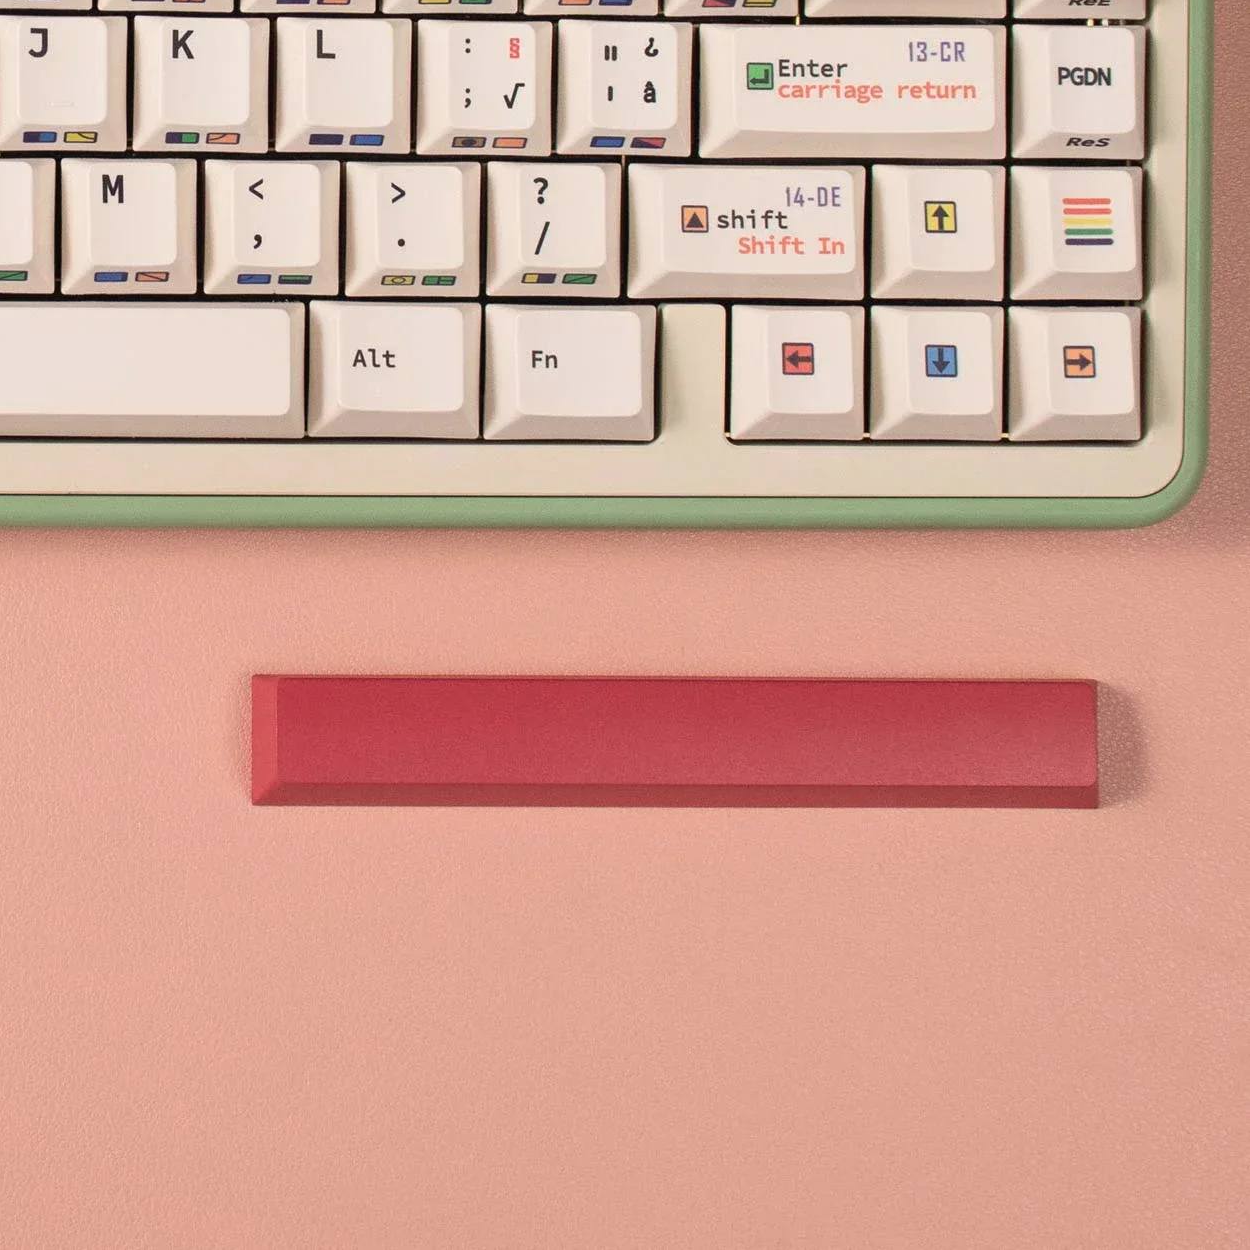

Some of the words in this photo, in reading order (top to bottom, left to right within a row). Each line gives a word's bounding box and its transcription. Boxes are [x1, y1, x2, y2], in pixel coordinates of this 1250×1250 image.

[28, 27, 49, 59] J
[171, 29, 195, 60] K
[316, 29, 336, 60] L
[464, 37, 471, 54] :
[908, 41, 966, 63] 13-CR
[779, 59, 847, 78] Enter
[1057, 66, 1112, 87] PGDN
[464, 87, 472, 109] ;
[778, 80, 883, 104] carriage
[897, 81, 977, 100] return
[1065, 137, 1111, 148] ReS
[101, 173, 125, 204] M
[248, 178, 264, 200] <
[390, 182, 407, 204] >
[533, 176, 549, 205] ?
[785, 186, 842, 208] 14-DE
[717, 208, 789, 230] shift
[253, 233, 263, 250] ,
[534, 221, 551, 256] /
[738, 234, 805, 255] Shift
[818, 236, 845, 255] In
[352, 348, 396, 369] Alt
[531, 349, 558, 369] Fn
